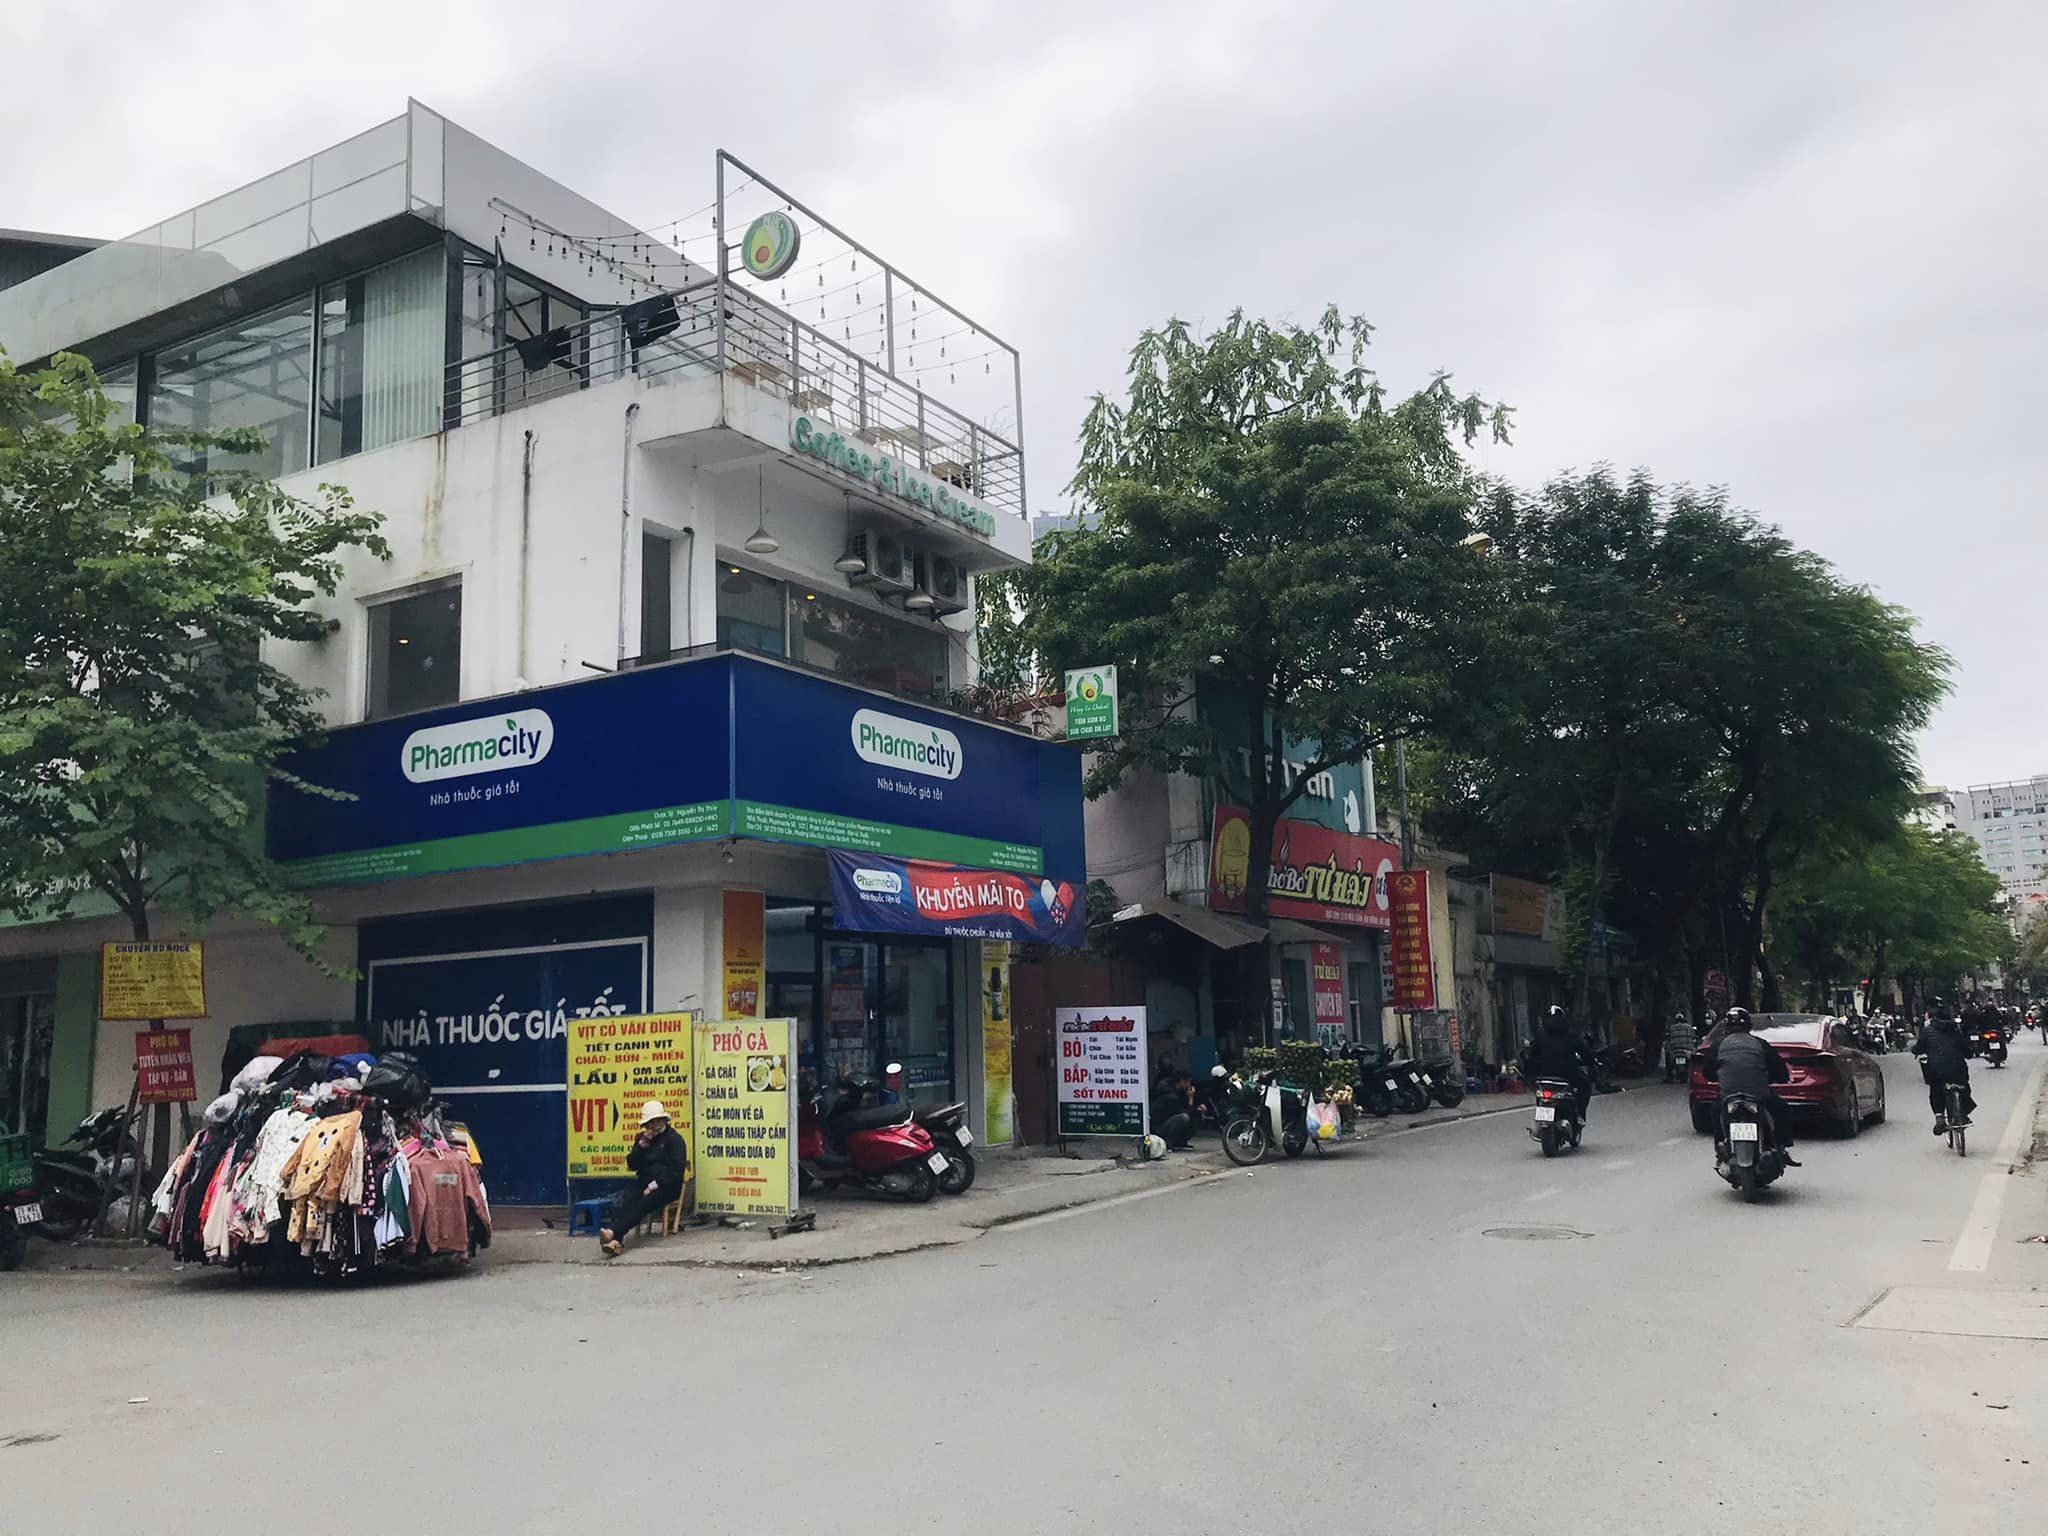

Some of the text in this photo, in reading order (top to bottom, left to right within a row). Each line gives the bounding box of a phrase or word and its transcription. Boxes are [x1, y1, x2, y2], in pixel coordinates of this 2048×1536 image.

[796, 416, 996, 537] Coffee & Ice Cream
[411, 720, 542, 773] Pharmacity
[860, 724, 956, 775] Pharmacity
[430, 779, 520, 806] Nhà thuốc giá tốt
[877, 778, 943, 800] Nhà thuốc giá tốt
[856, 874, 899, 891] Pharmacity
[915, 876, 1024, 911] KHUYẾN MÃI TO
[381, 1008, 431, 1046] NHÀ
[436, 994, 520, 1045] THUỐC
[525, 997, 567, 1041] GIÁ
[578, 1025, 596, 1040] VỊT
[712, 1026, 768, 1052] PHỞ GÀ
[614, 1040, 649, 1051] CANH
[1063, 1036, 1081, 1057] BÒ
[633, 1066, 651, 1076] OM
[668, 1075, 688, 1084] CAY
[706, 1065, 716, 1079] GÀ
[1064, 1063, 1088, 1083] BẮP
[728, 1084, 738, 1099] GÀ
[1073, 1087, 1128, 1099] SỐT VANG
[571, 1098, 608, 1140] VỊT
[706, 1105, 721, 1120] CÁC
[753, 1105, 764, 1120] GÀ
[725, 1126, 745, 1139] RANG
[725, 1145, 746, 1158] RANG
